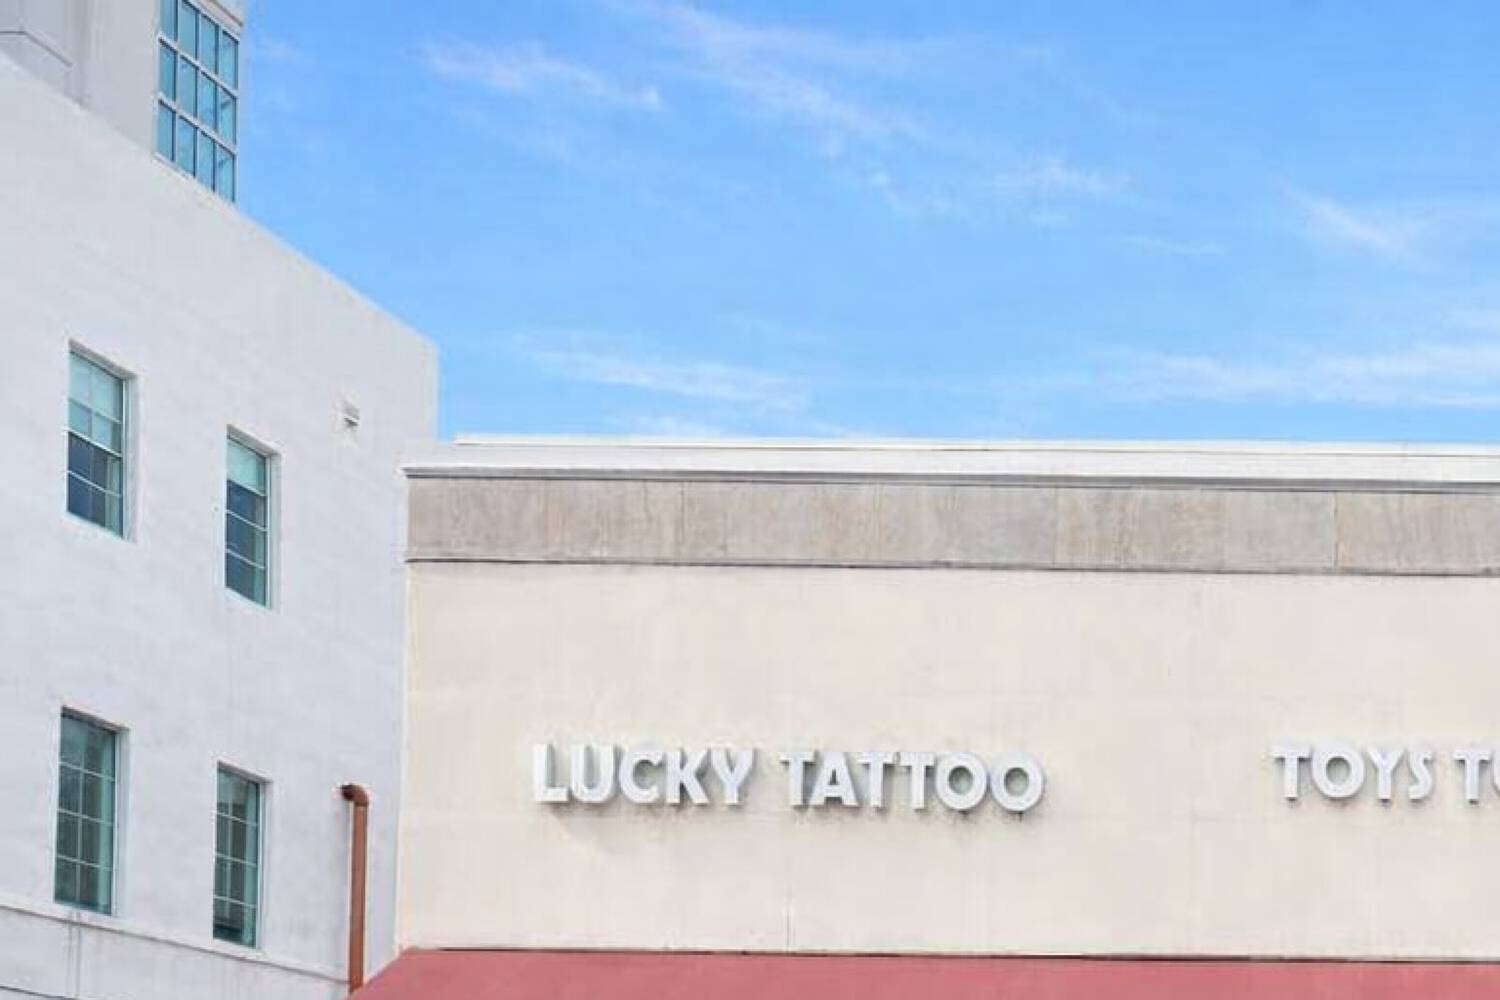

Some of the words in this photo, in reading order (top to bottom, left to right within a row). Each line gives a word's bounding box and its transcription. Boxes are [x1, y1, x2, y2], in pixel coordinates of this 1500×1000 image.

[532, 743, 756, 806] LUCKY
[780, 750, 1046, 812] TATTOO
[1273, 744, 1433, 803] TOYS
